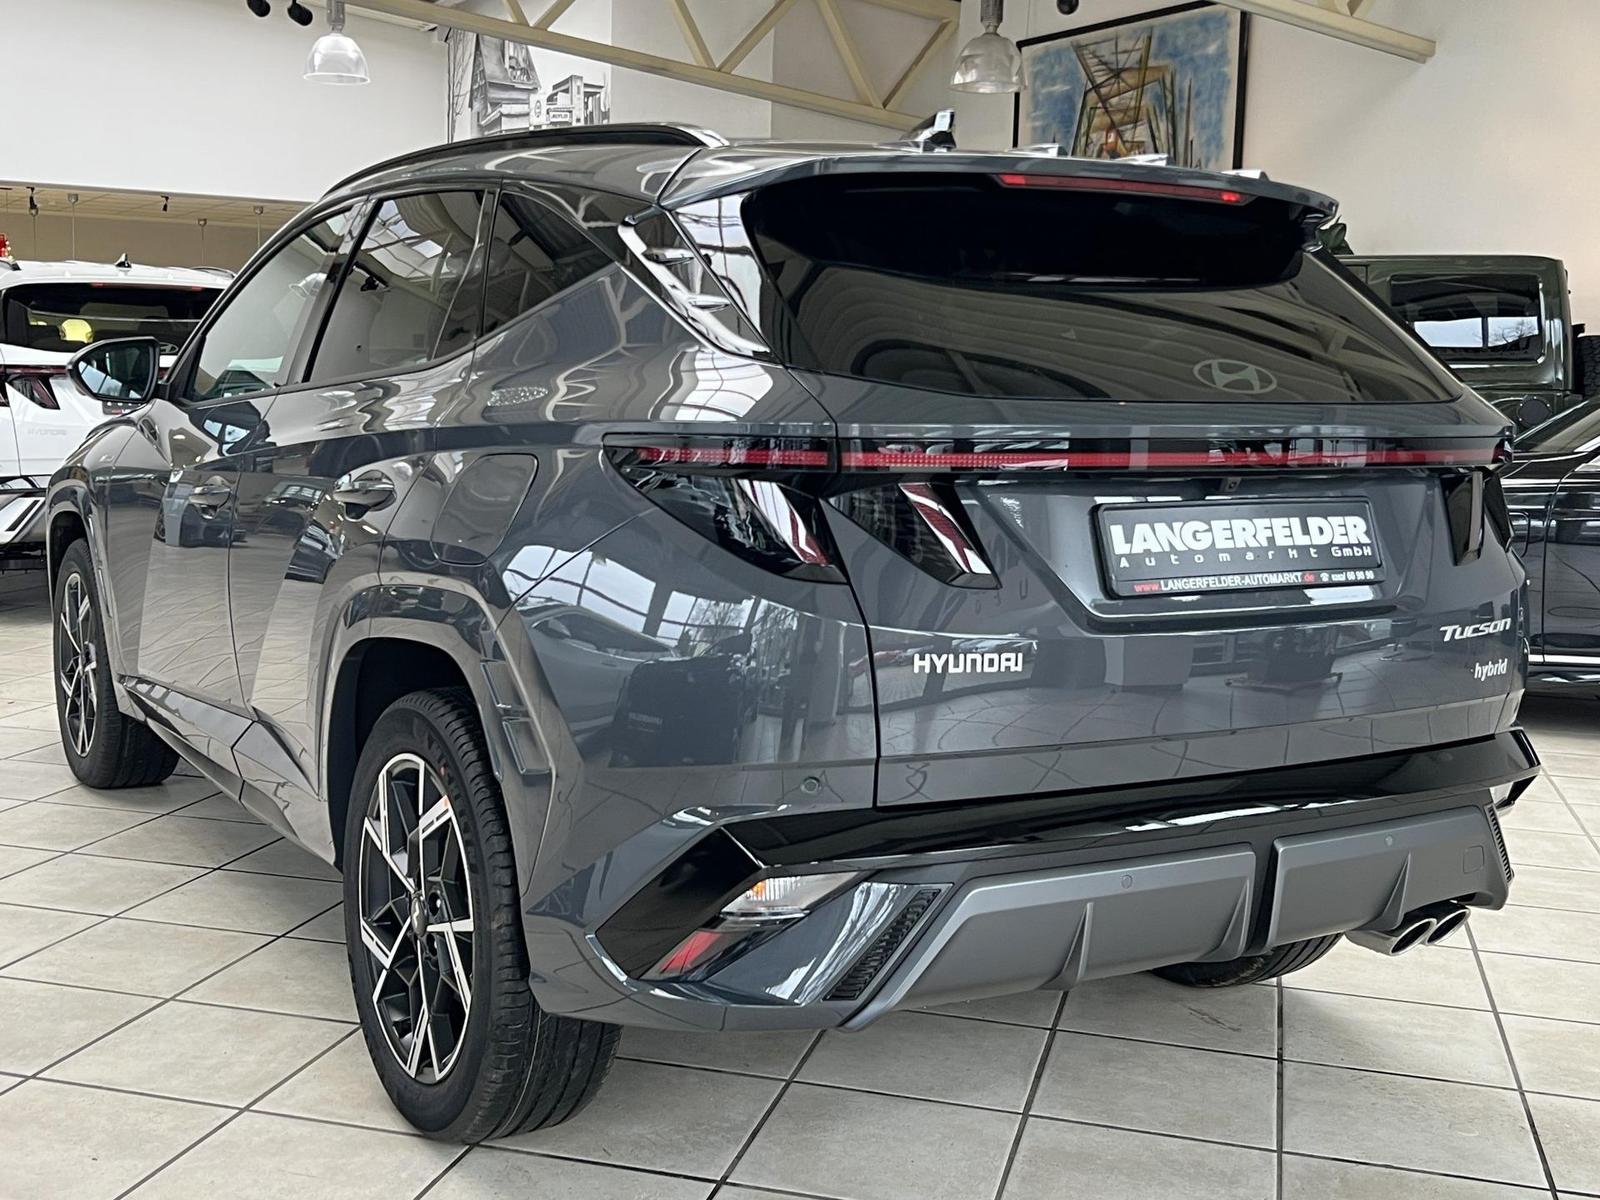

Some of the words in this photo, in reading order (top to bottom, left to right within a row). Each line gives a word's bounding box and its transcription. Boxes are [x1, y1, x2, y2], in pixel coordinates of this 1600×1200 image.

[1110, 516, 1371, 554] LANGERFELDER
[1331, 546, 1372, 557] GmbH
[1440, 618, 1511, 642] Tucson
[913, 653, 1023, 673] HYUNDAI
[1474, 658, 1508, 681] hybrid
